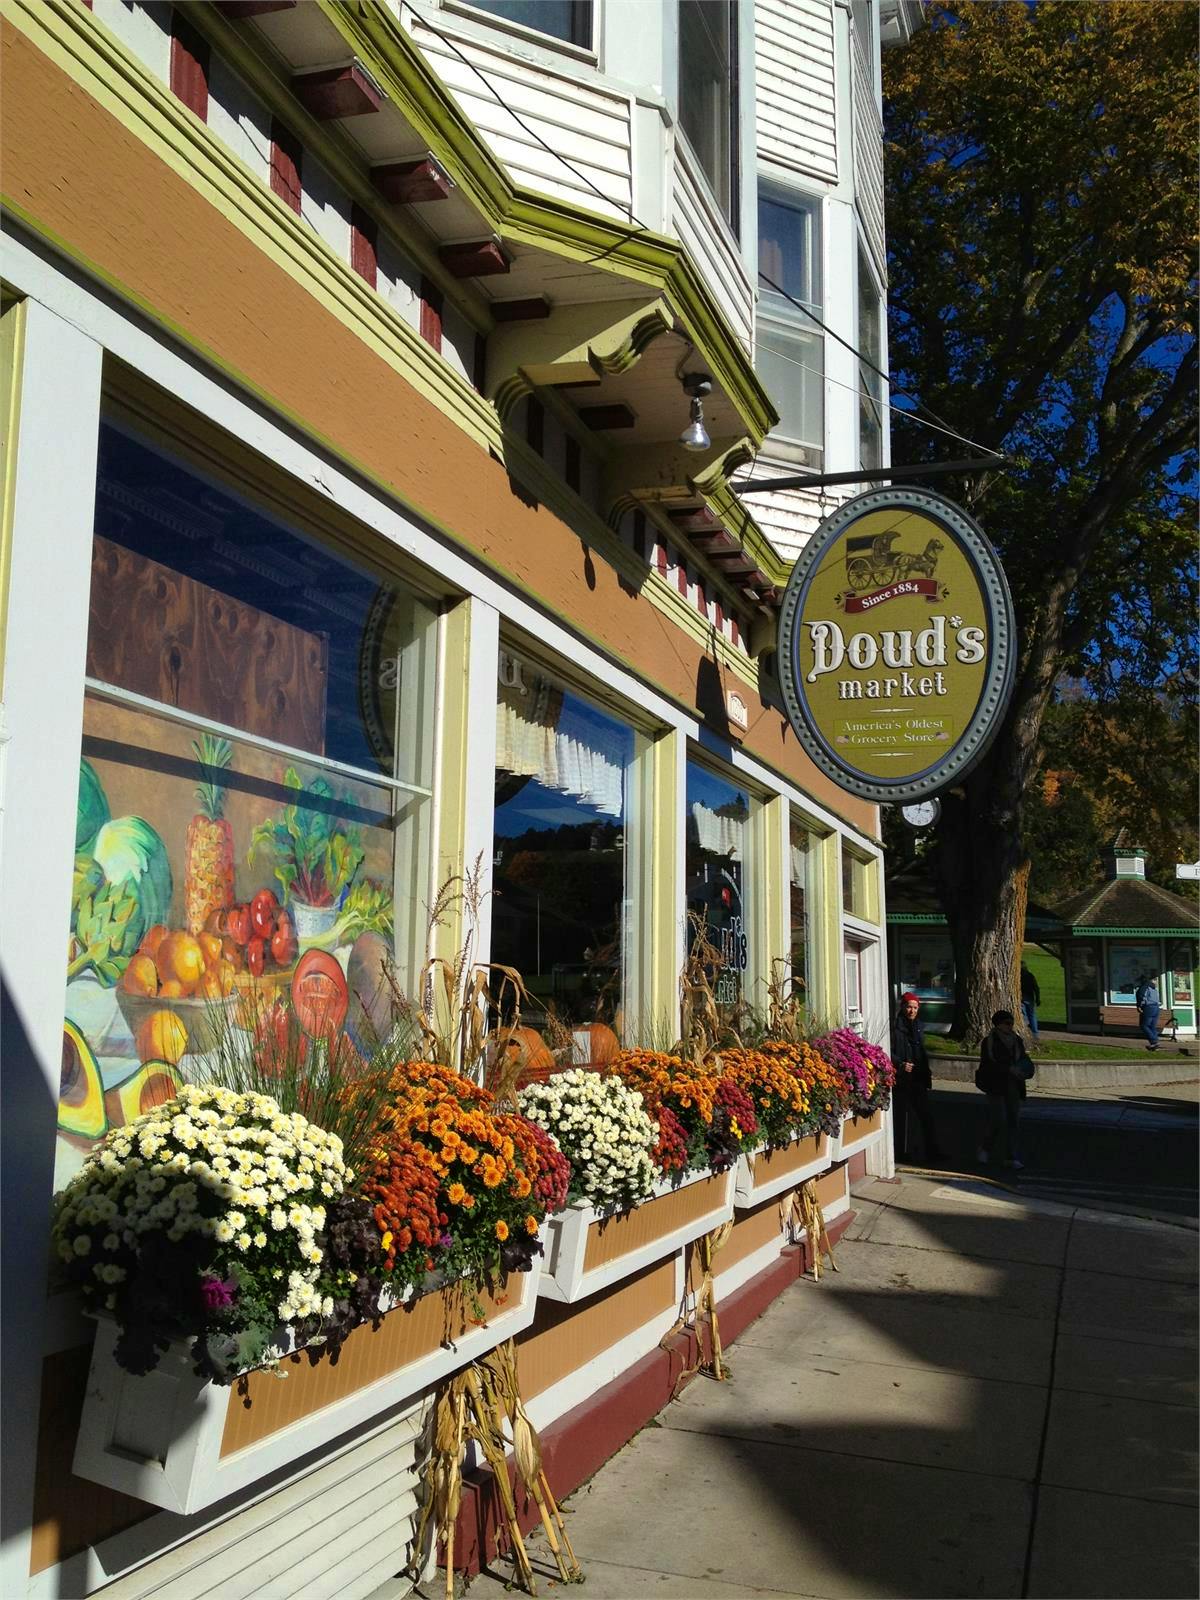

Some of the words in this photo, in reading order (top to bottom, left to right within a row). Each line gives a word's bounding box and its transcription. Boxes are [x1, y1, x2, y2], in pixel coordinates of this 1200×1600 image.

[861, 591, 892, 609] Since
[893, 582, 919, 595] 1884
[802, 615, 986, 683] Doud's
[839, 672, 948, 700] market
[842, 720, 902, 732] America's
[906, 719, 944, 729] Oldest
[851, 734, 898, 745] Grocery
[903, 732, 935, 742] Store
